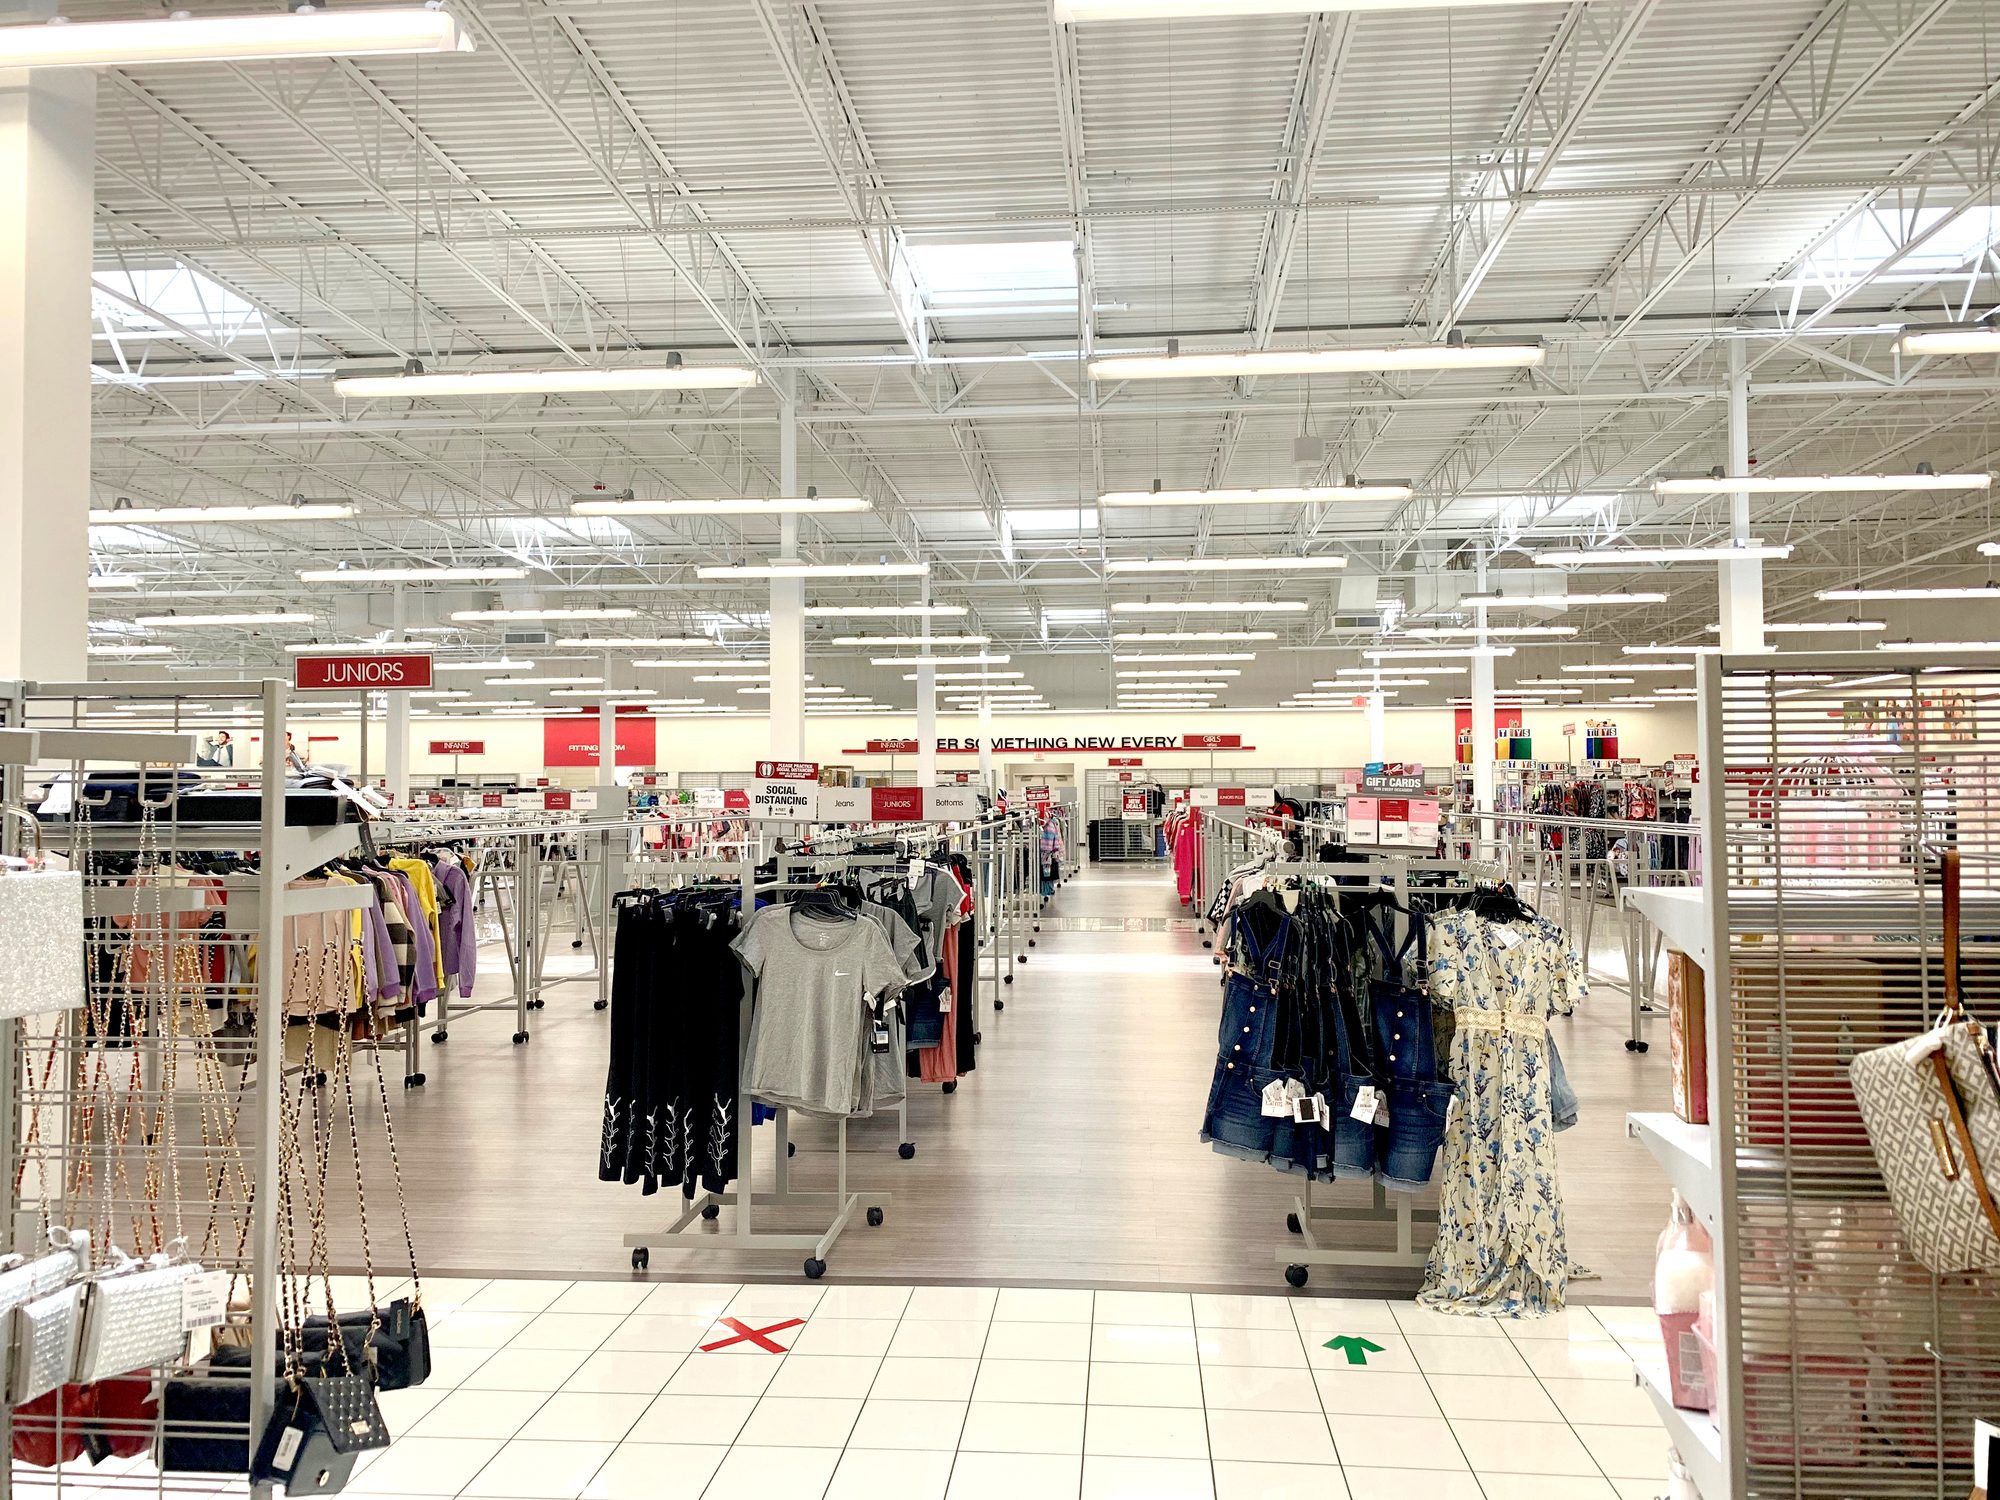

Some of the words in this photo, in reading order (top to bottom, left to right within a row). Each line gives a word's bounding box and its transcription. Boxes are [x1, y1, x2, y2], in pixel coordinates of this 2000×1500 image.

[322, 662, 404, 682] JUNIORS
[1074, 737, 1115, 749] NEW
[1121, 736, 1177, 748] EVERY
[1202, 735, 1221, 743] GIRLS
[1508, 760, 1537, 768] TYS
[1366, 776, 1387, 787] GIFT
[1389, 777, 1421, 788] CARDS
[766, 785, 797, 795] SOCIAL
[755, 795, 808, 805] DISTANCING
[834, 799, 855, 807] Jeans
[883, 800, 911, 808] JUNIORS
[935, 799, 964, 807] Bottoms
